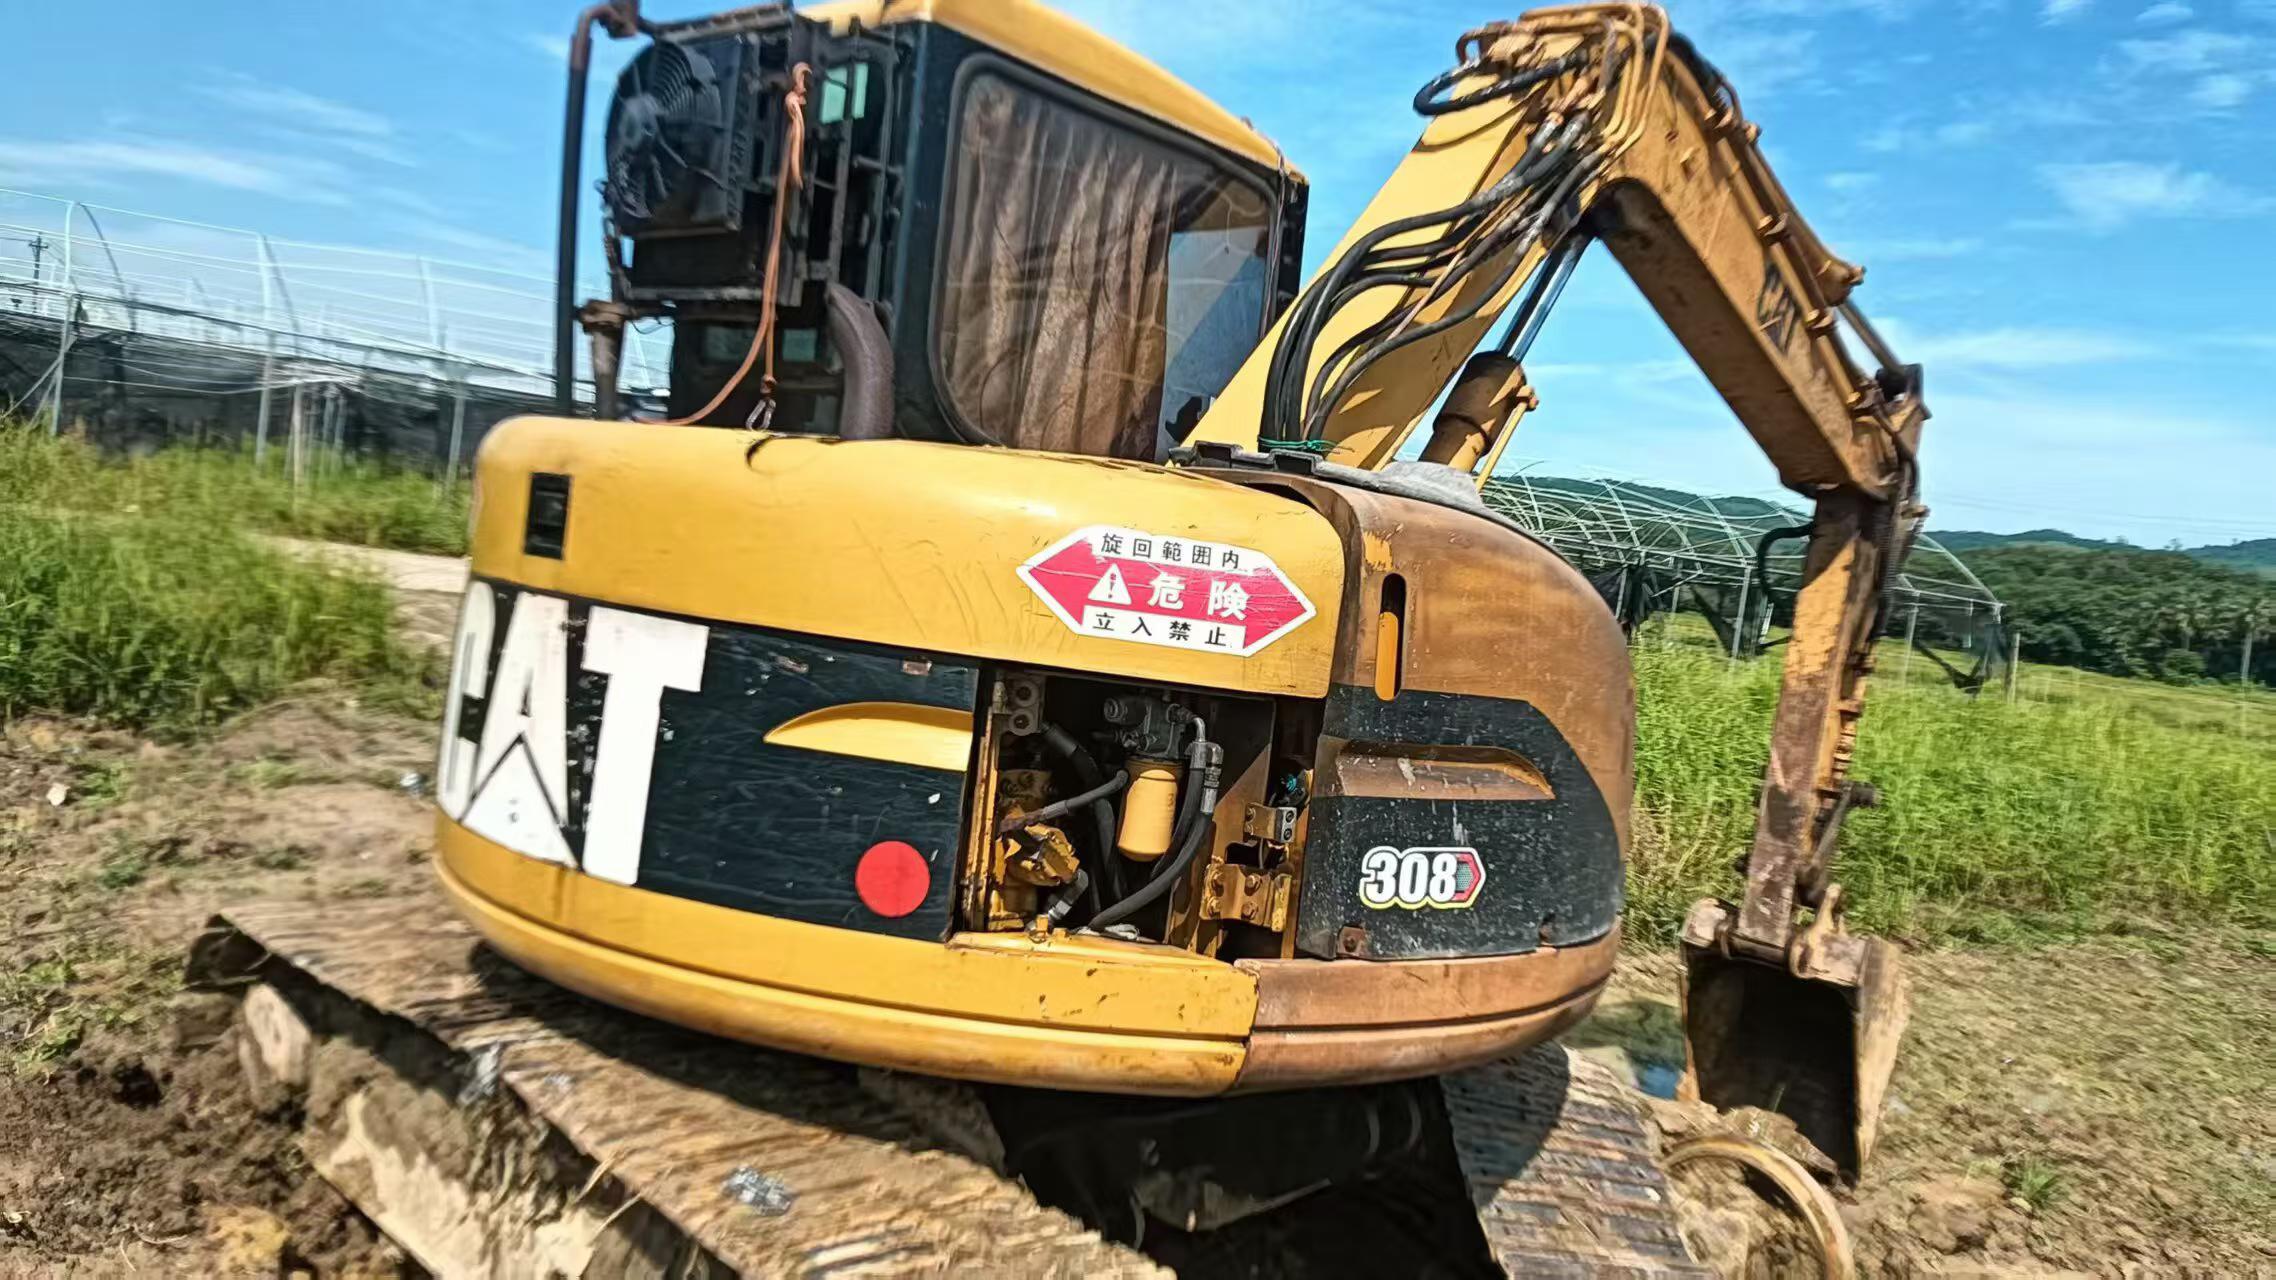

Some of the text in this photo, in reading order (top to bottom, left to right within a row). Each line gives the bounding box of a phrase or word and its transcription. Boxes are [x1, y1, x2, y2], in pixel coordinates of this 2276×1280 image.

[1101, 531, 1240, 569] 旋回範囲内
[1147, 571, 1250, 621] 危険
[1092, 612, 1227, 647] 立入禁止
